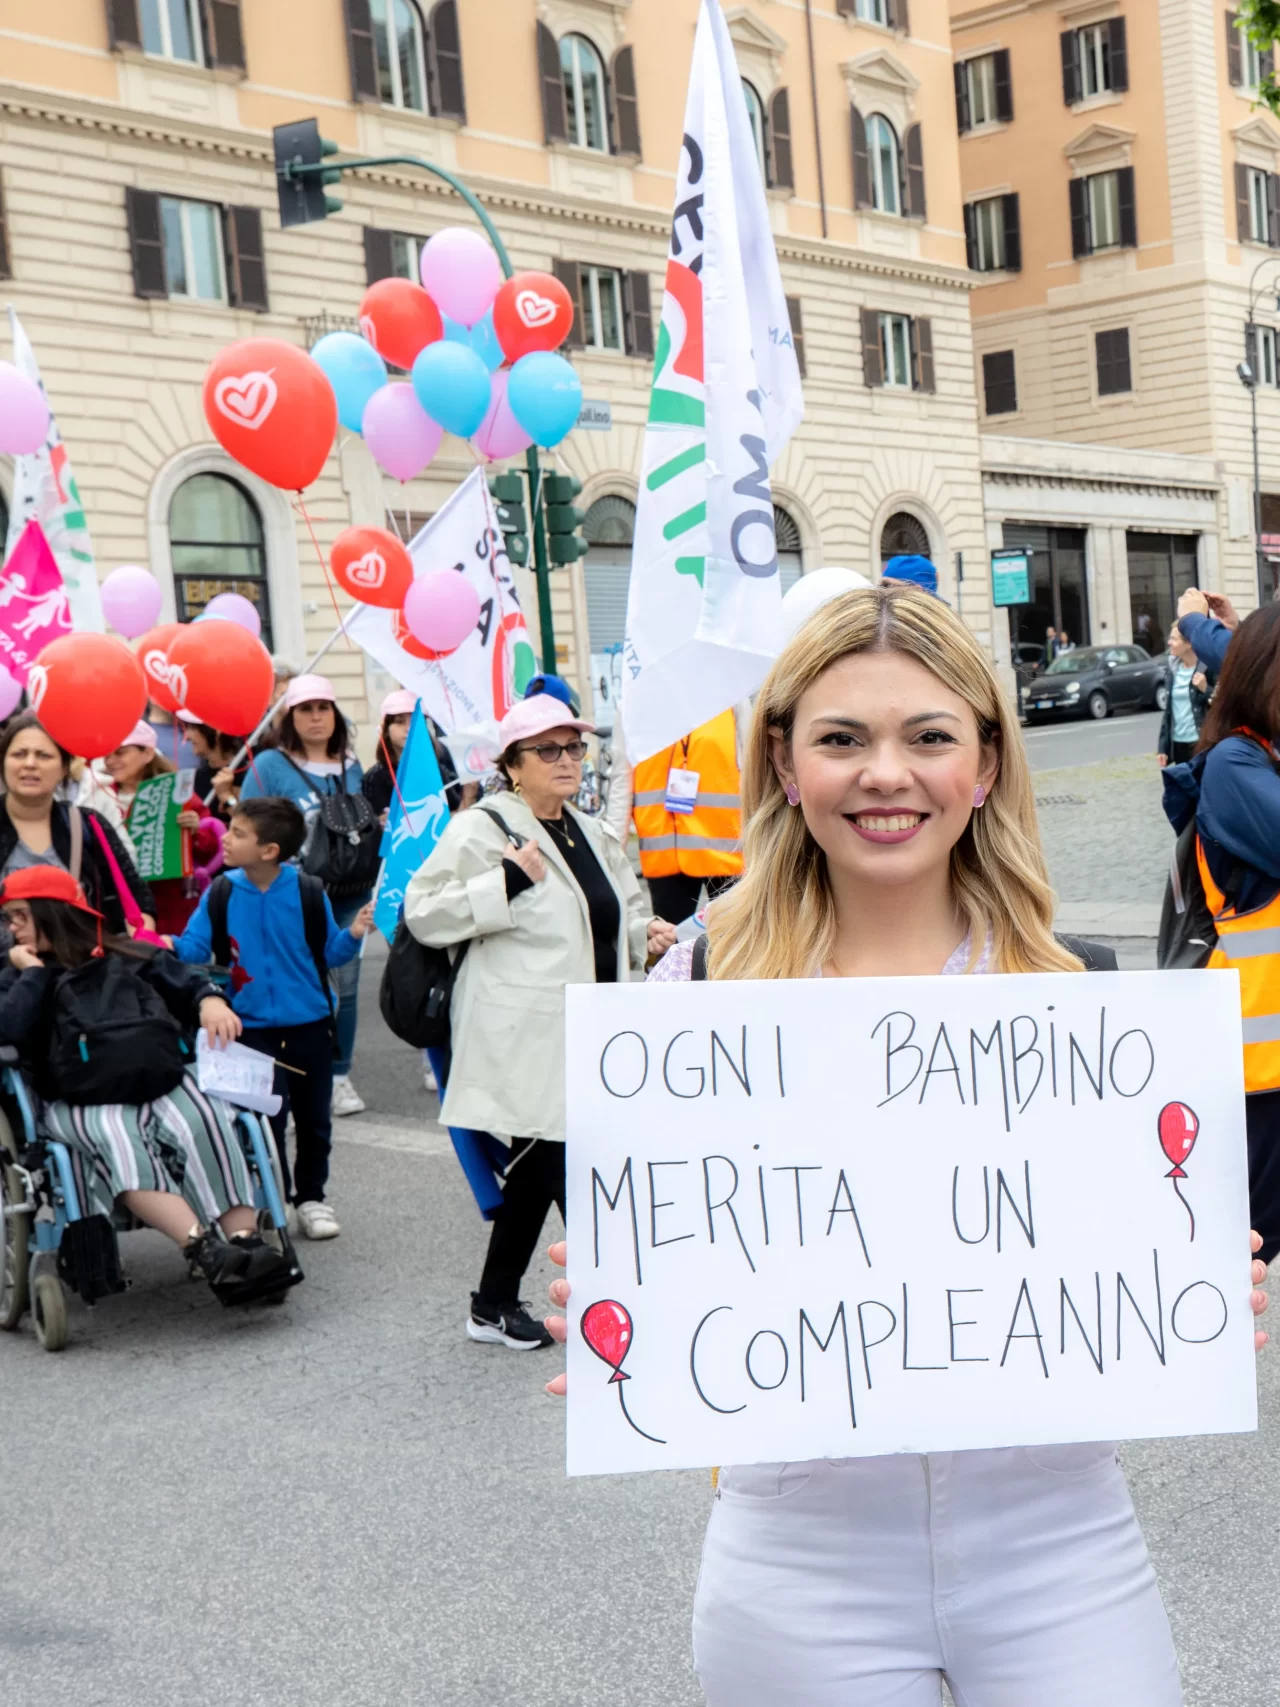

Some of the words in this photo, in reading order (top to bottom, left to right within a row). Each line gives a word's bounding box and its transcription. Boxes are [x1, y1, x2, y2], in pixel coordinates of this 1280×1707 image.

[600, 1024, 788, 1099] OGNI
[871, 1005, 1155, 1133] BAMBINO
[591, 1143, 872, 1286] MERITA
[952, 1159, 1036, 1254] UN
[690, 1248, 1228, 1429] COMPLEANNO
